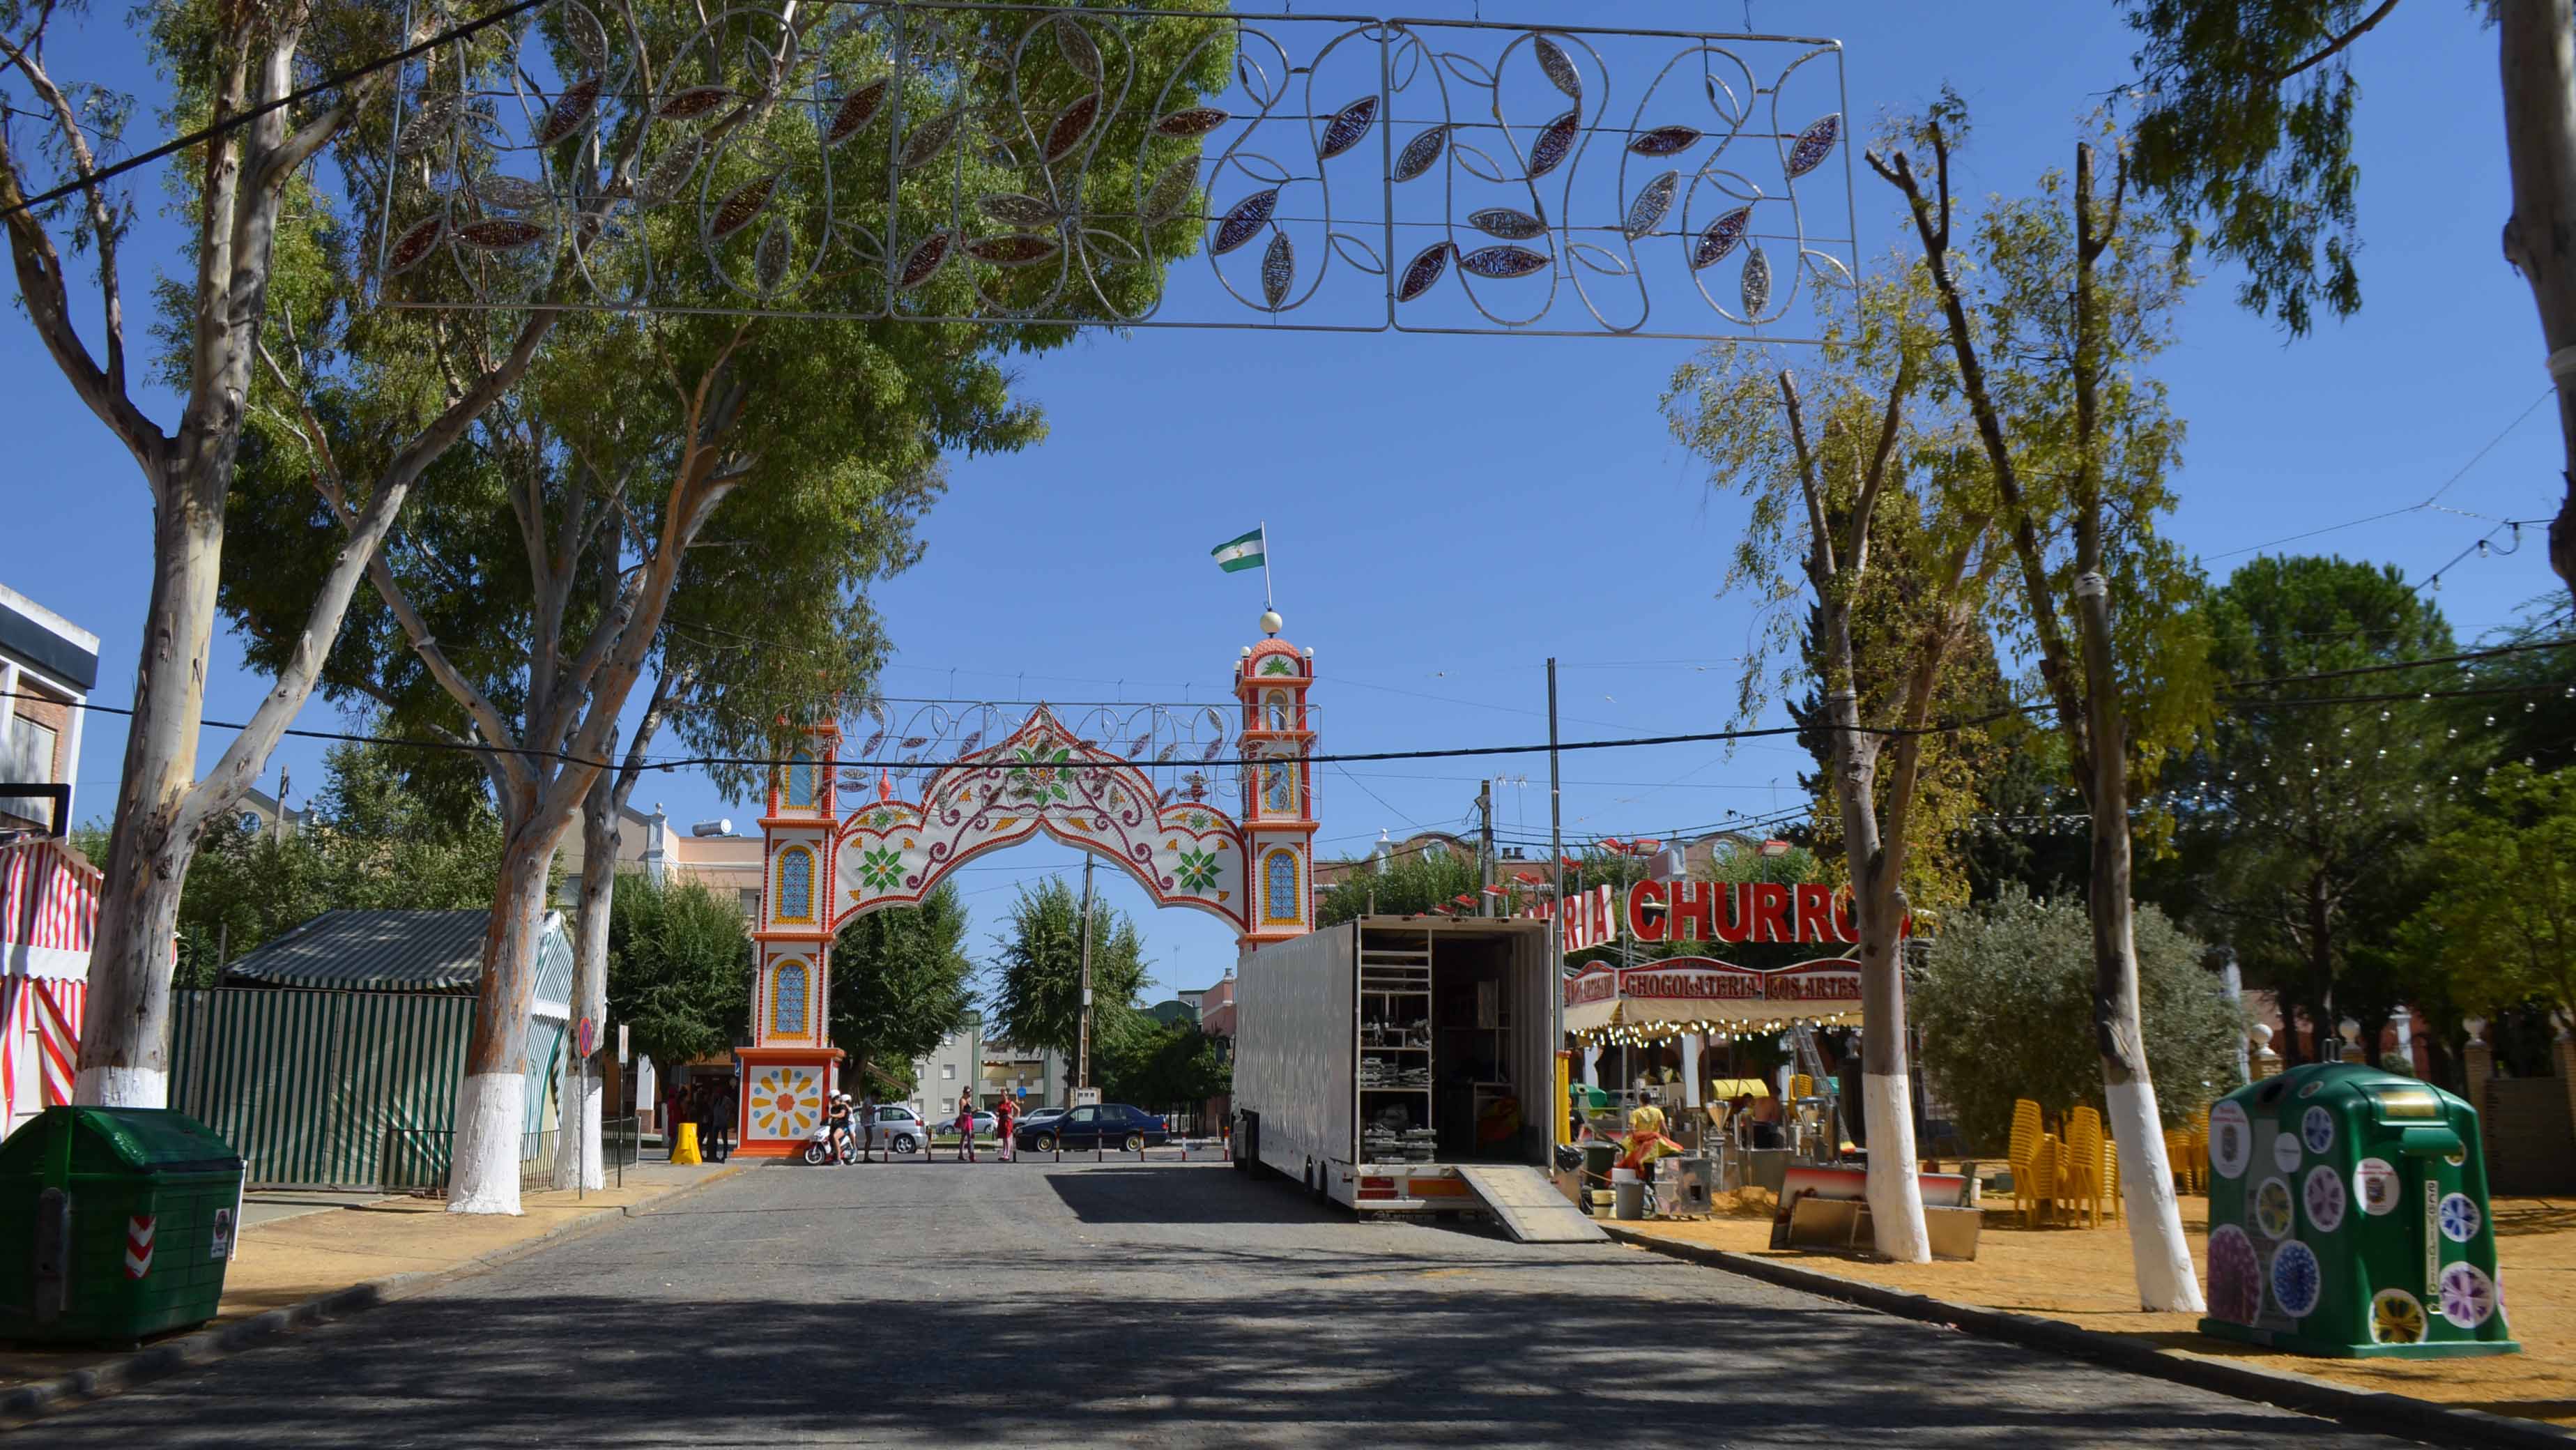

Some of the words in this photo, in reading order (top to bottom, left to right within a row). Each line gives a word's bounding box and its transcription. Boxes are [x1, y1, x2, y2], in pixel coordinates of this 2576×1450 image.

[1627, 879, 1911, 944] CHURRO
[1765, 975, 1800, 1000] LOS
[1804, 976, 1862, 998] ARTES
